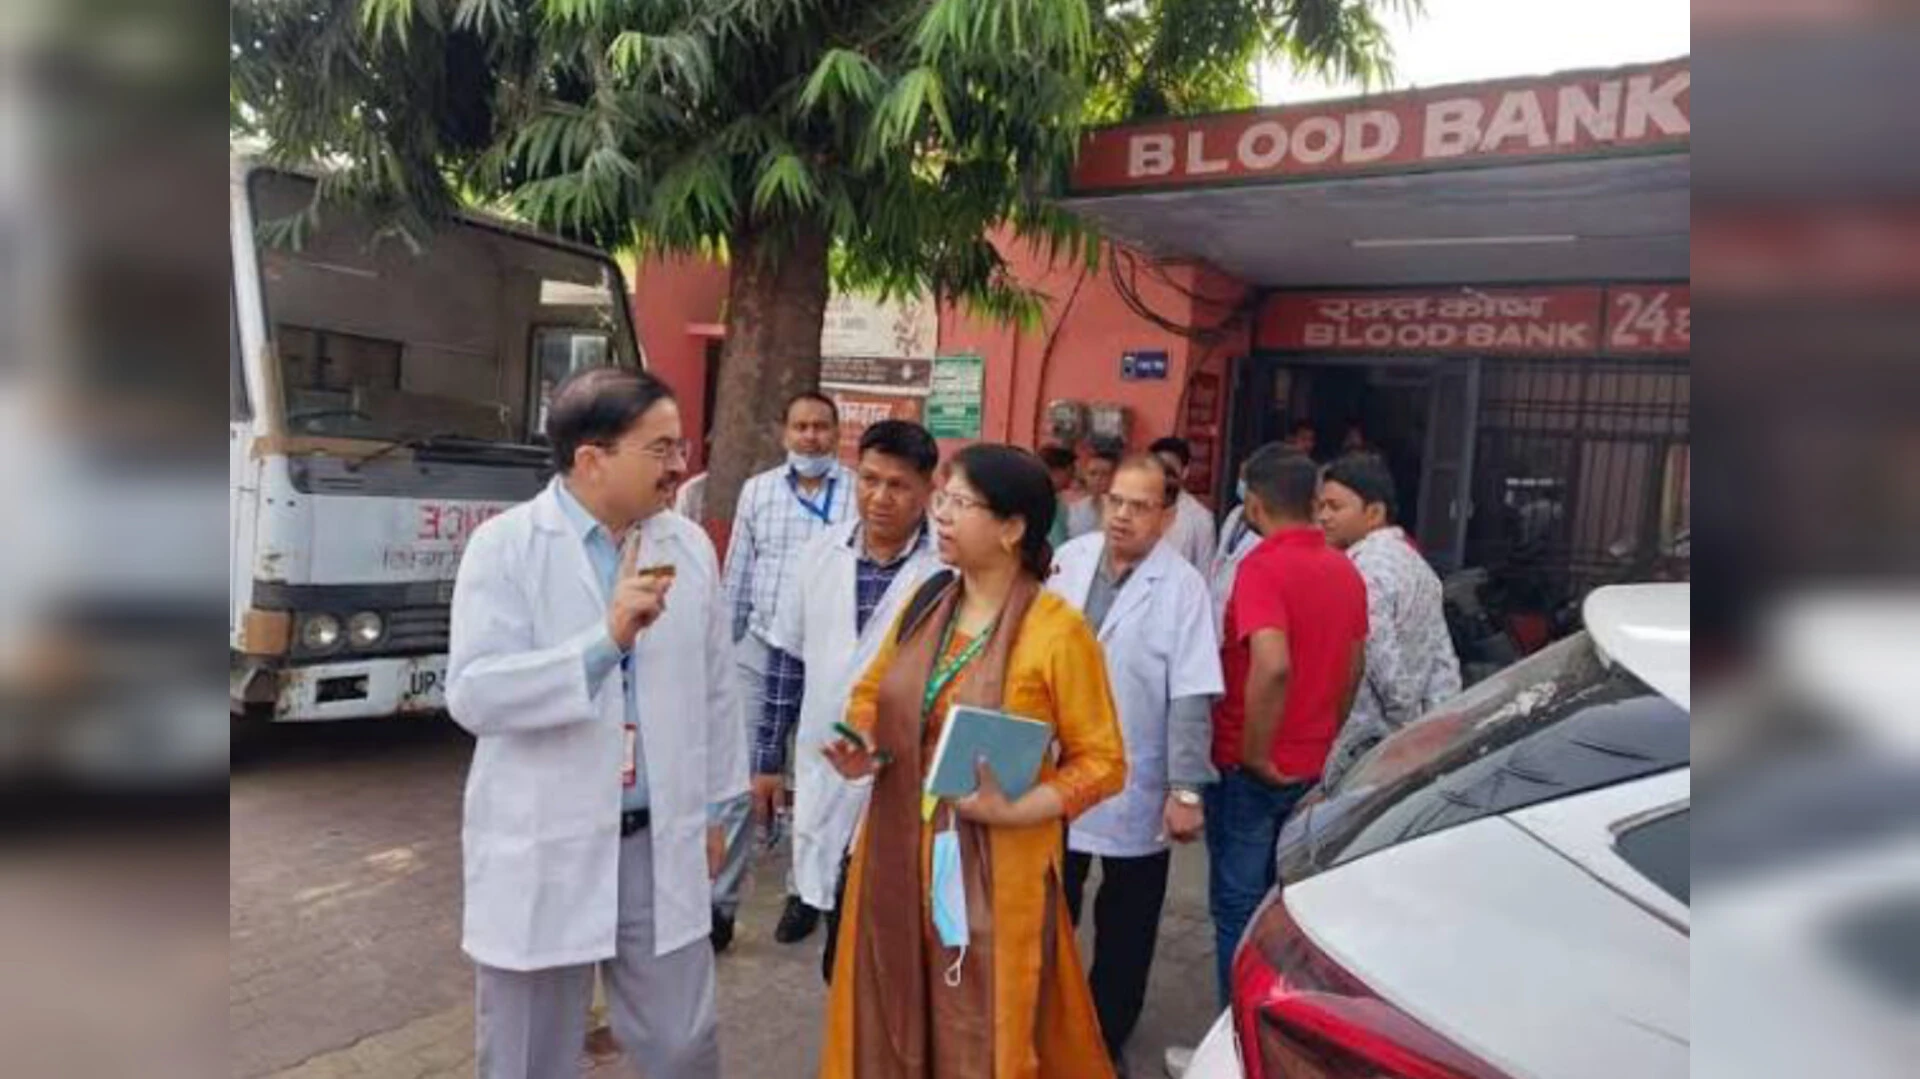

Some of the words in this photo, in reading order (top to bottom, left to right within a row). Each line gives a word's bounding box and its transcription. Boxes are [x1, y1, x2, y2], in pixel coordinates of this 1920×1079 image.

[1127, 109, 1400, 177] BLOOD
[1421, 71, 1690, 158] BANK
[1611, 291, 1671, 347] 24
